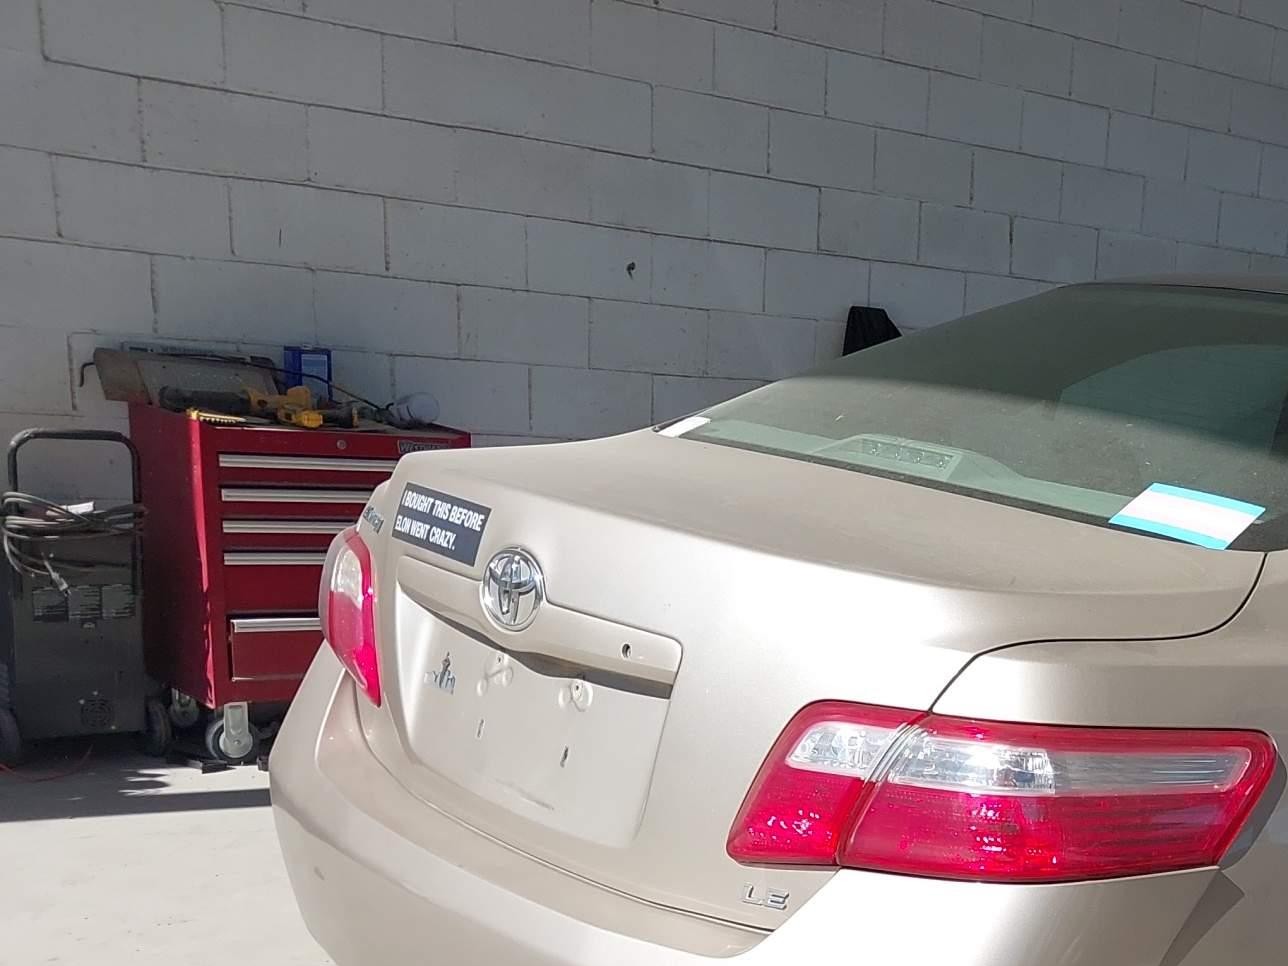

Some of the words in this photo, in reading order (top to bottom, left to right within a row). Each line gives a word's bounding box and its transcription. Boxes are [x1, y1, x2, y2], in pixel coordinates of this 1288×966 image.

[402, 490, 408, 505] I
[404, 491, 434, 514] BOUGHT
[432, 500, 451, 520] THIS
[449, 505, 485, 531] BEFORE
[395, 515, 411, 533] ELON
[410, 520, 430, 540] WENT
[429, 526, 456, 550] CRAZY.
[742, 882, 790, 910] LE
